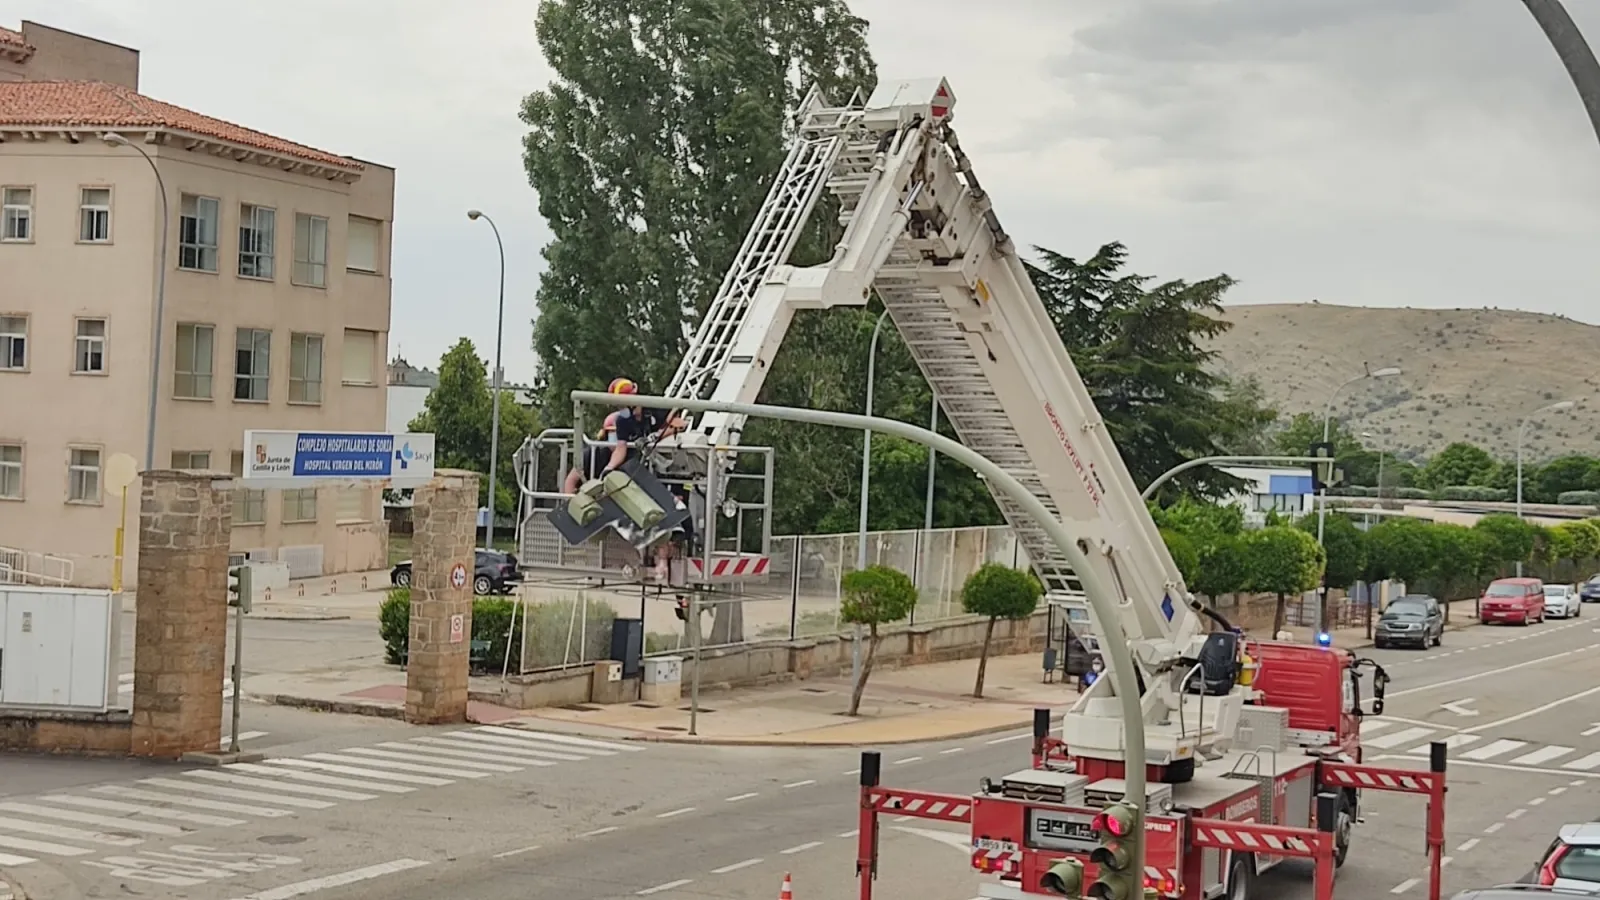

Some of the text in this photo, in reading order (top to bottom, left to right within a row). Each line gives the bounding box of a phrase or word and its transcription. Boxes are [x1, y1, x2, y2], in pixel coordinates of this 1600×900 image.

[297, 437, 393, 453] COMPLEJO HOSPITALARIO DE SORIA
[415, 451, 432, 463] Sacyl
[252, 463, 271, 471] Castilla
[276, 463, 290, 471] León
[304, 457, 384, 471] HOSPITAL VIRGEN DEL MIRÓN
